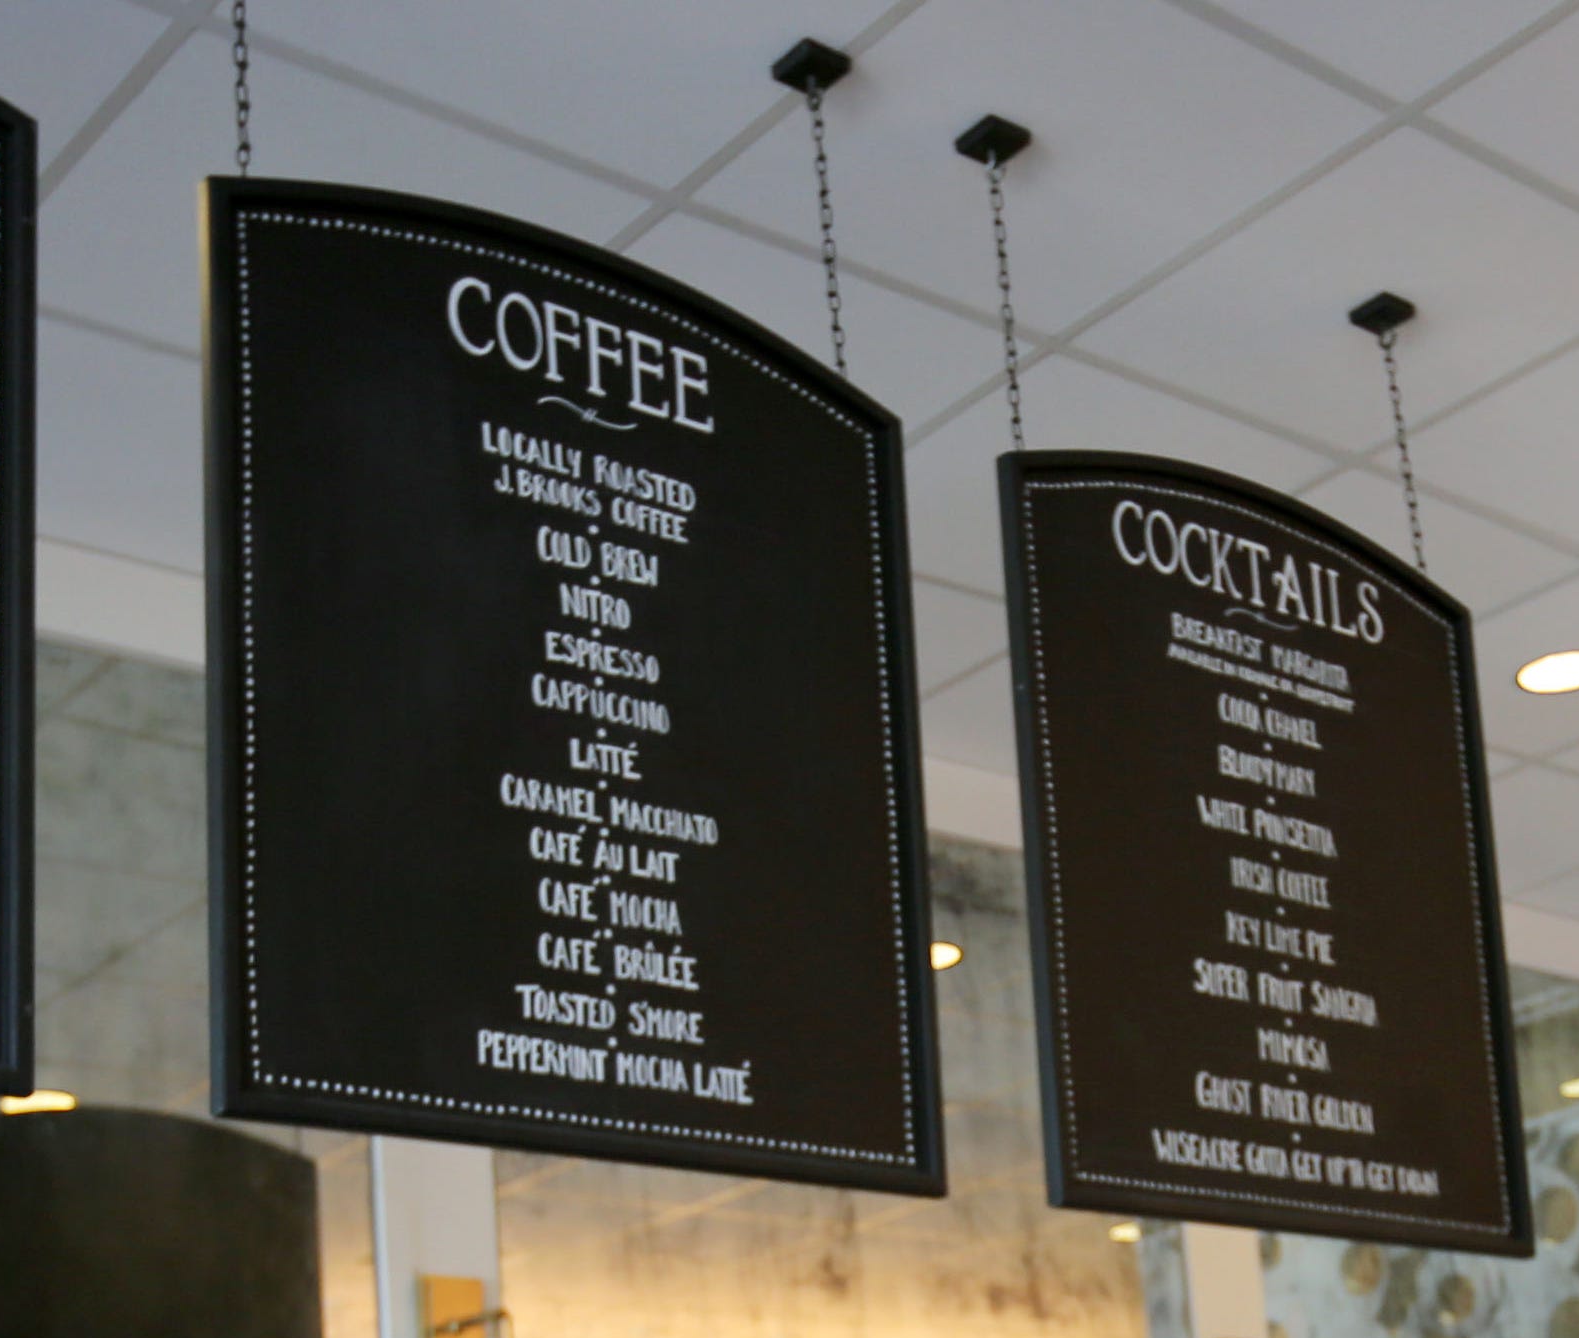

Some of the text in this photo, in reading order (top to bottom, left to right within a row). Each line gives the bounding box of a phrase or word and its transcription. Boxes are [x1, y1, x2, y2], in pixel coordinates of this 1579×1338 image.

[447, 277, 714, 433] COFFEE
[481, 422, 696, 511] LOCALLY ROASTED
[612, 497, 689, 543] COFFEE
[537, 526, 658, 586] COLD BREW
[1112, 500, 1385, 644] COCKTAILS
[559, 583, 631, 629] NITRO
[545, 631, 660, 683] ESPRESSO
[532, 674, 670, 734] CAPPUCCINO
[500, 774, 718, 845] CARAMEL MACCHIATO
[630, 845, 680, 883] LAIT
[1229, 856, 1275, 895] IRISH
[609, 891, 682, 935] MOCHA
[1225, 909, 1336, 966] KEY LIME PIE
[1193, 957, 1250, 1003] SUPER
[515, 984, 616, 1030] TOASTED
[477, 1029, 608, 1083] PEPPERMINT
[616, 1051, 687, 1093] MOCHA
[1257, 1027, 1331, 1072] MIMOSA
[1195, 1070, 1252, 1116] GHOST
[1260, 1082, 1312, 1125] RIVER
